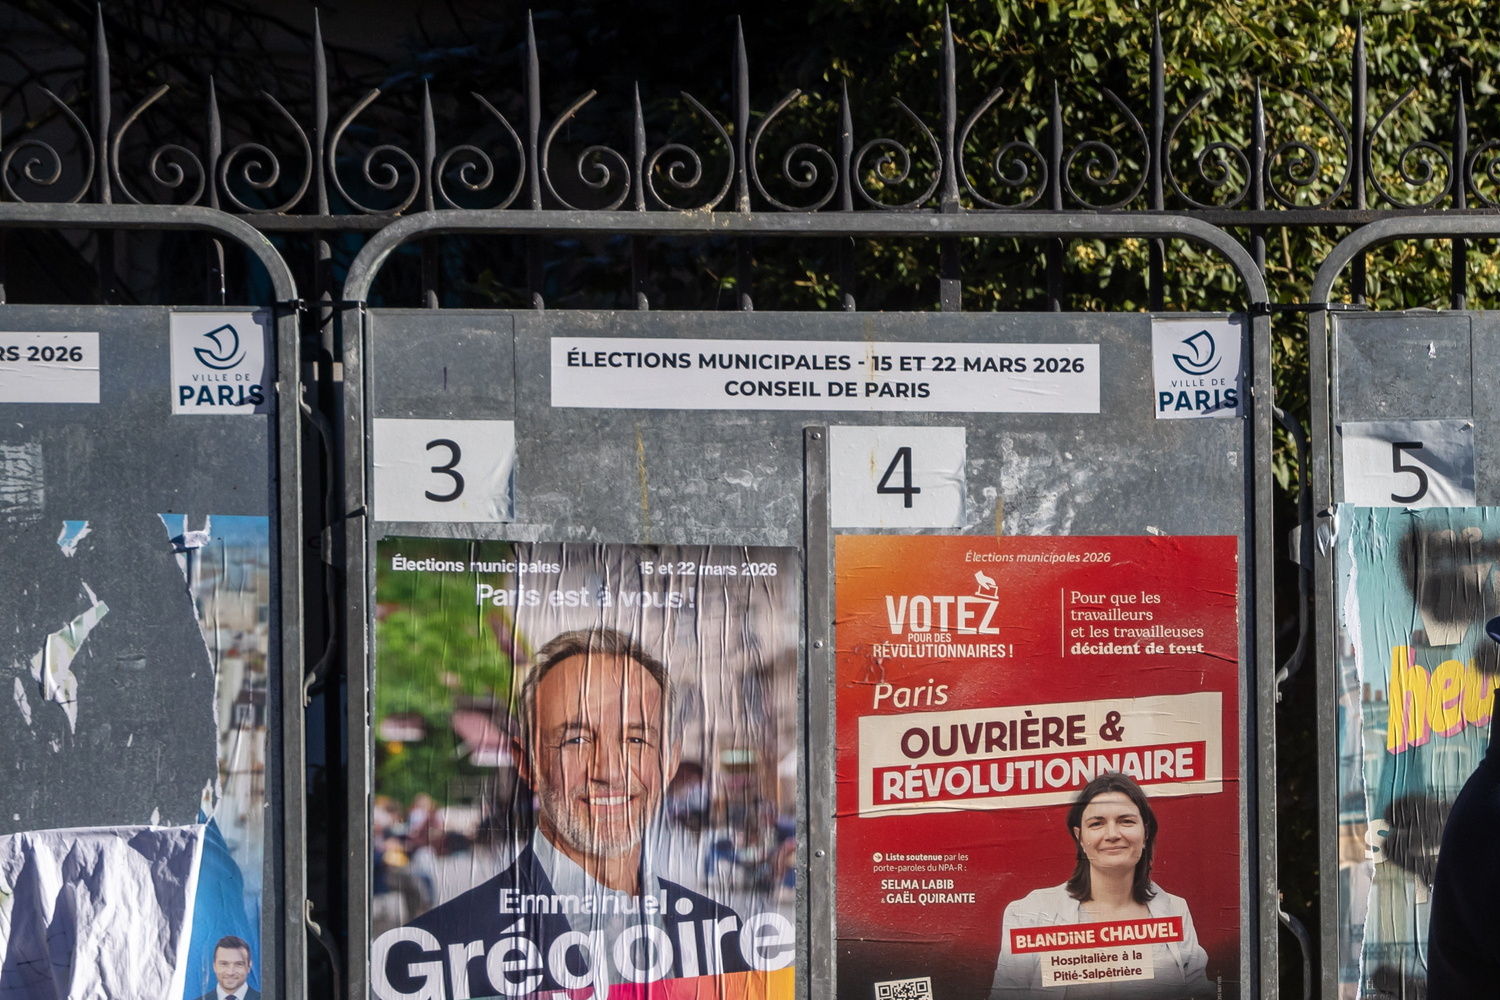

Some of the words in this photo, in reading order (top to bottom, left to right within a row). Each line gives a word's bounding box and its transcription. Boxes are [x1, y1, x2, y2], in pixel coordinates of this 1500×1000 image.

[27, 346, 83, 362] 2026
[567, 347, 692, 368] ÉLECTIONS
[698, 353, 851, 372] MUNICIPALES
[871, 356, 893, 372] 15
[900, 356, 926, 372] ET
[931, 356, 957, 372] 22
[963, 357, 1027, 373] MARS
[1033, 357, 1085, 374] 2026
[191, 373, 228, 382] VILLE
[235, 373, 251, 382] DE
[179, 385, 265, 406] PARIS
[724, 380, 821, 397] CONSEIL
[828, 382, 857, 398] DE
[864, 382, 931, 398] PARIS
[1158, 388, 1239, 412] PARIS
[424, 438, 465, 503] 3
[877, 446, 921, 508] 4
[1391, 441, 1429, 504] 5
[391, 554, 465, 572] Élections
[965, 550, 1015, 563] Élections
[1017, 552, 1080, 565] municipales
[1082, 552, 1111, 563] 2026
[658, 561, 674, 575] et
[677, 562, 695, 575] 22
[741, 562, 777, 577] 2026
[476, 584, 541, 607] Paris
[549, 586, 589, 607] est
[1071, 591, 1106, 605] Pour
[1110, 594, 1137, 608] que
[1140, 591, 1161, 605] les
[885, 595, 999, 635] VOTEZ
[1071, 608, 1153, 621] travailleurs
[908, 633, 932, 643] POUR
[934, 633, 952, 643] DES
[1071, 626, 1085, 639] et
[1089, 625, 1109, 639] les
[1113, 625, 1204, 639] travailleuses
[873, 642, 1006, 658] RÉVOLUTIONNAIRES
[1071, 642, 1140, 656] décident
[1145, 643, 1165, 655] de
[1169, 643, 1204, 655] tout
[873, 679, 948, 709] Paris
[900, 710, 1086, 759] OUVRIÈRE
[1099, 710, 1124, 742] &
[883, 747, 1194, 801] RÉVOLUTIONNAIRE
[885, 853, 904, 861] Liste
[906, 853, 942, 861] soutenue
[881, 879, 919, 890] SELMA
[922, 879, 954, 890] LABIB
[500, 888, 668, 915] Emmanuel
[886, 891, 916, 904] GAËL
[918, 893, 976, 906] QUIRANTE
[1099, 922, 1178, 943] CHAUVEL
[1051, 953, 1118, 967] Hospitalière
[1132, 950, 1142, 961] la
[1053, 966, 1142, 982] Pitié-Salpêtrière
